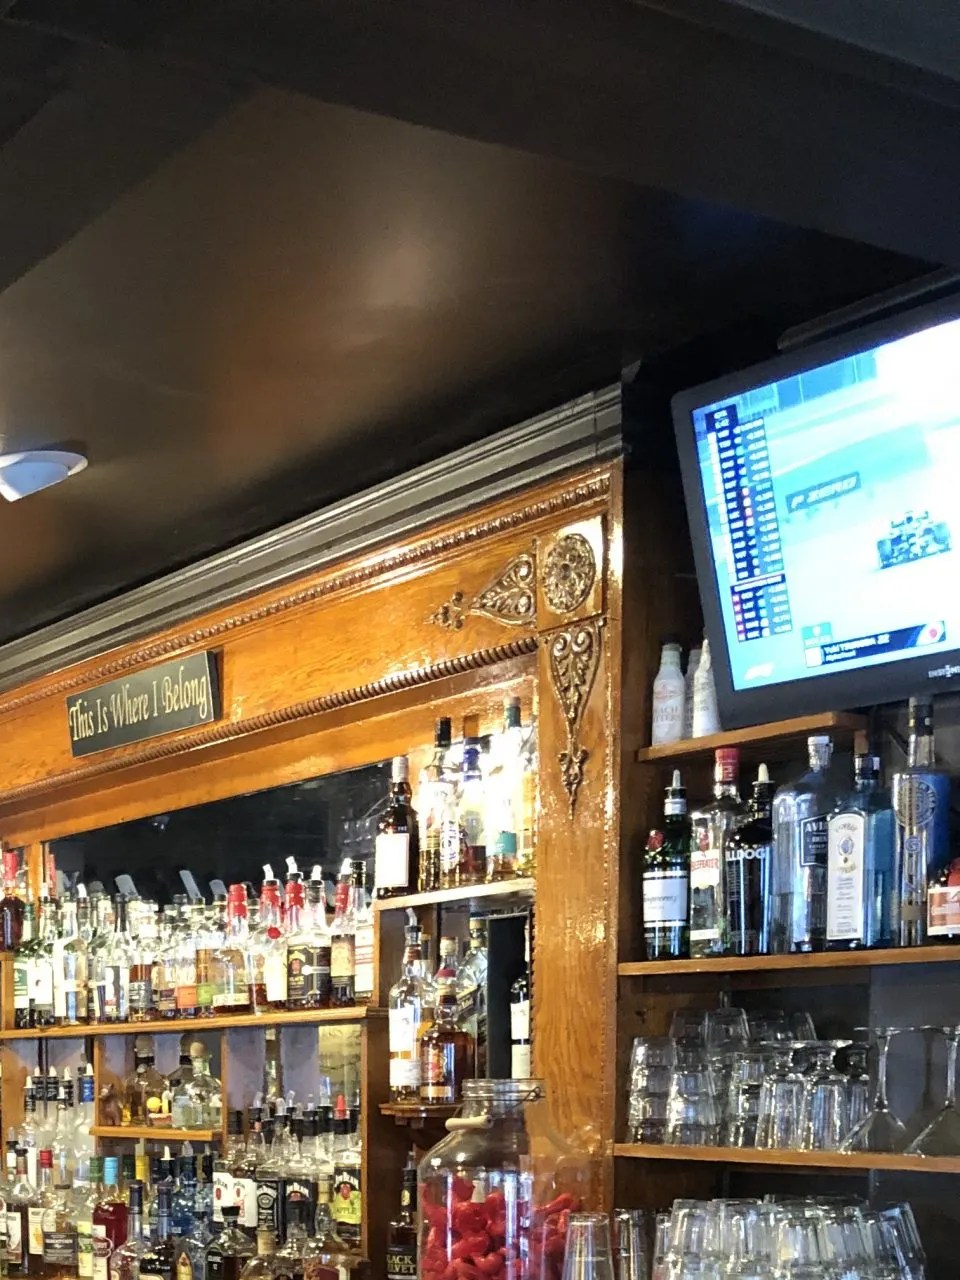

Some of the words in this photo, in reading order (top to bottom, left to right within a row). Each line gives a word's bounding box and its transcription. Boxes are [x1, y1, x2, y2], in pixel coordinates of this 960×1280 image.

[69, 699, 94, 741] This
[96, 698, 109, 733] Is
[109, 683, 150, 728] Where
[152, 681, 158, 717] I
[161, 666, 208, 719] Belong
